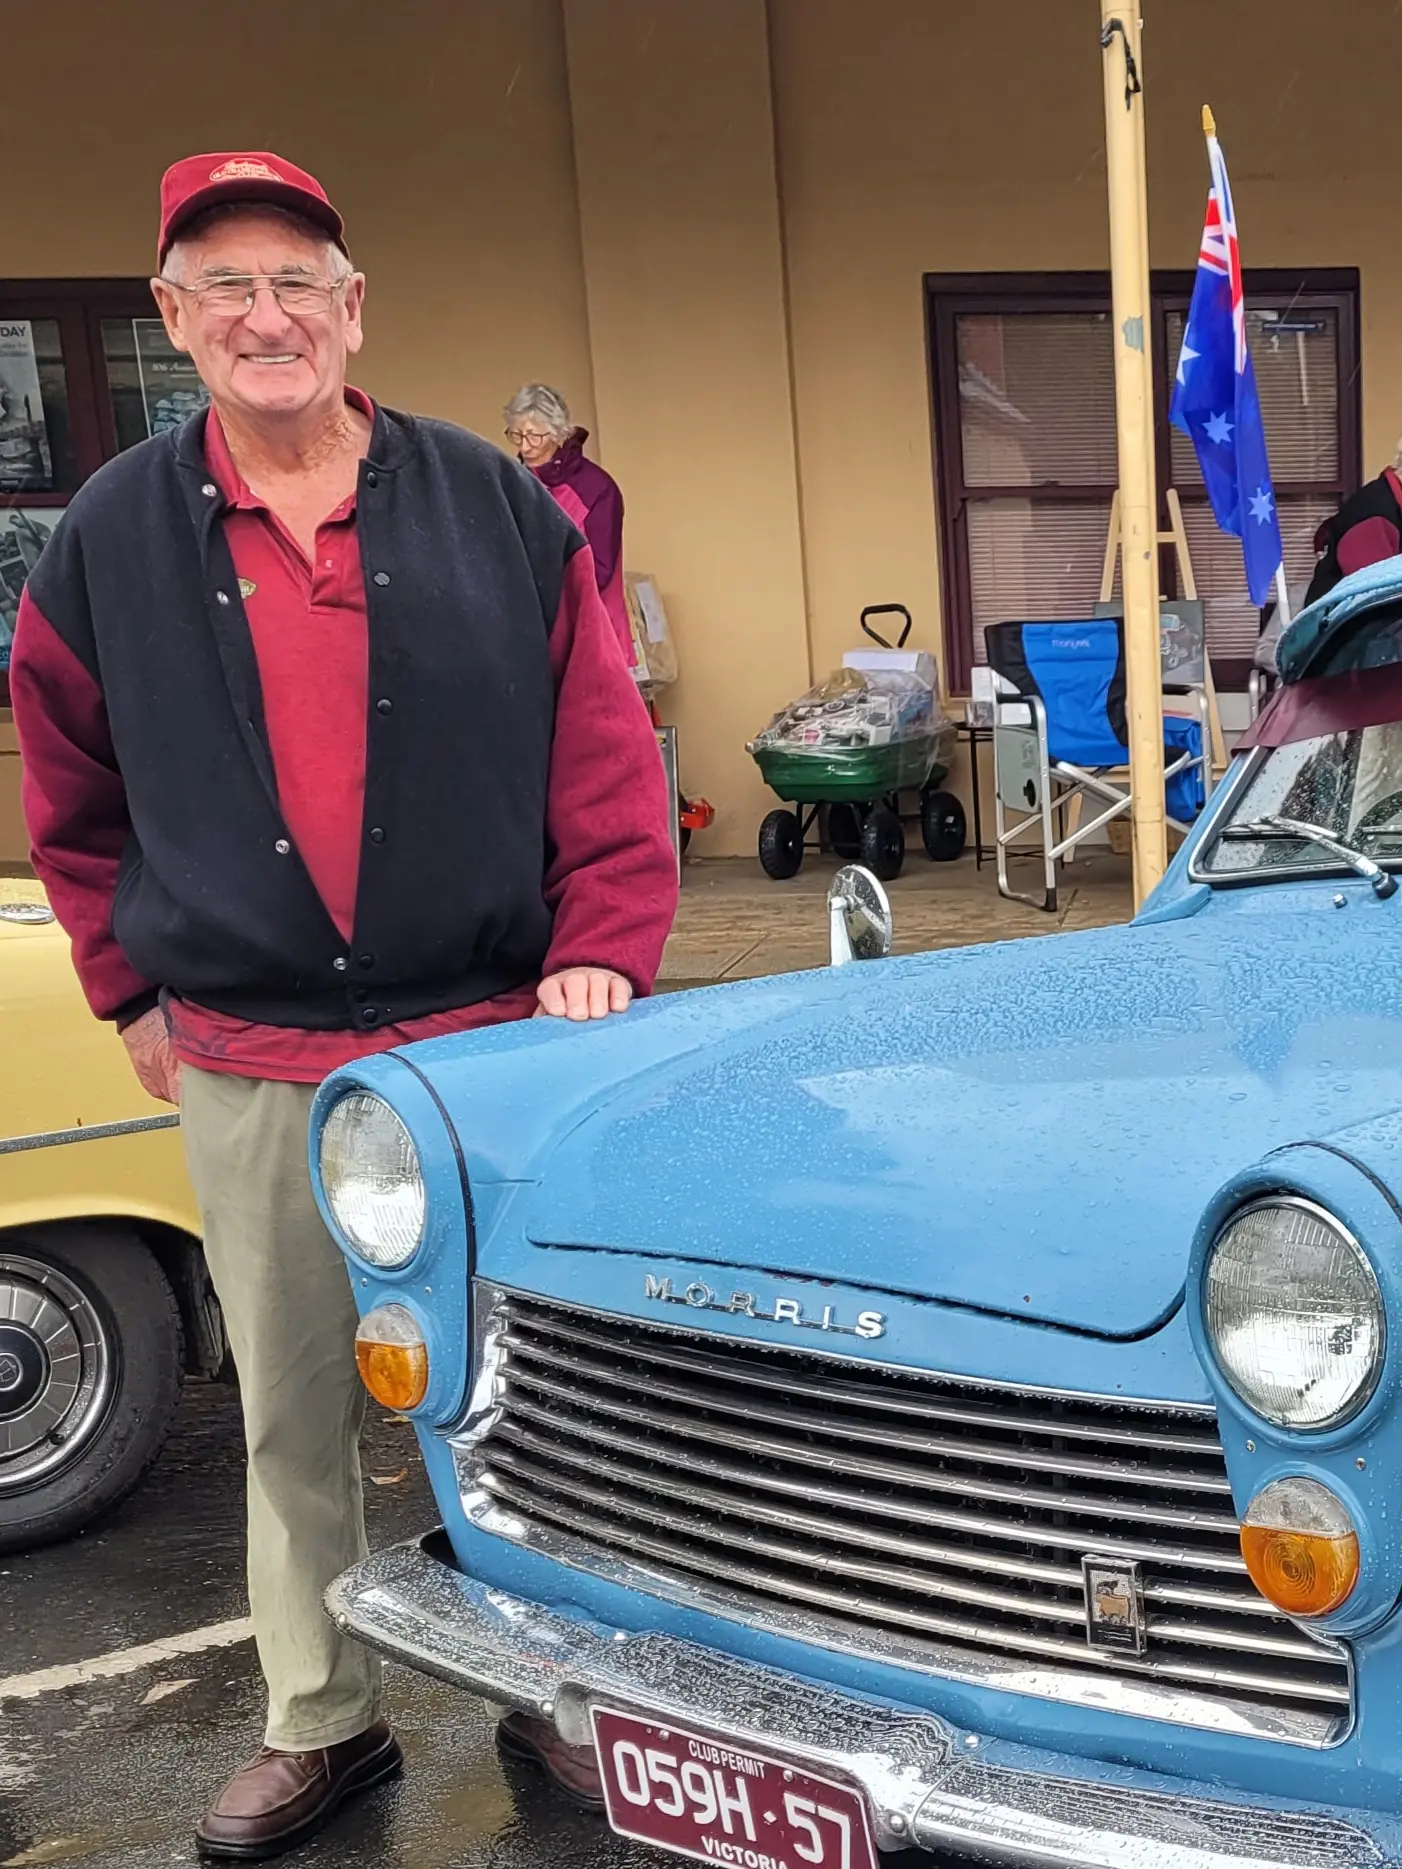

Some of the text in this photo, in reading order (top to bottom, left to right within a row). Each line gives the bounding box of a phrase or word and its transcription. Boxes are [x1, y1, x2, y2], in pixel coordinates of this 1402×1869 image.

[644, 1273, 887, 1340] MORRIS
[688, 1739, 766, 1780] CLUB PERMIT
[700, 1835, 790, 1869] VICTORIA
